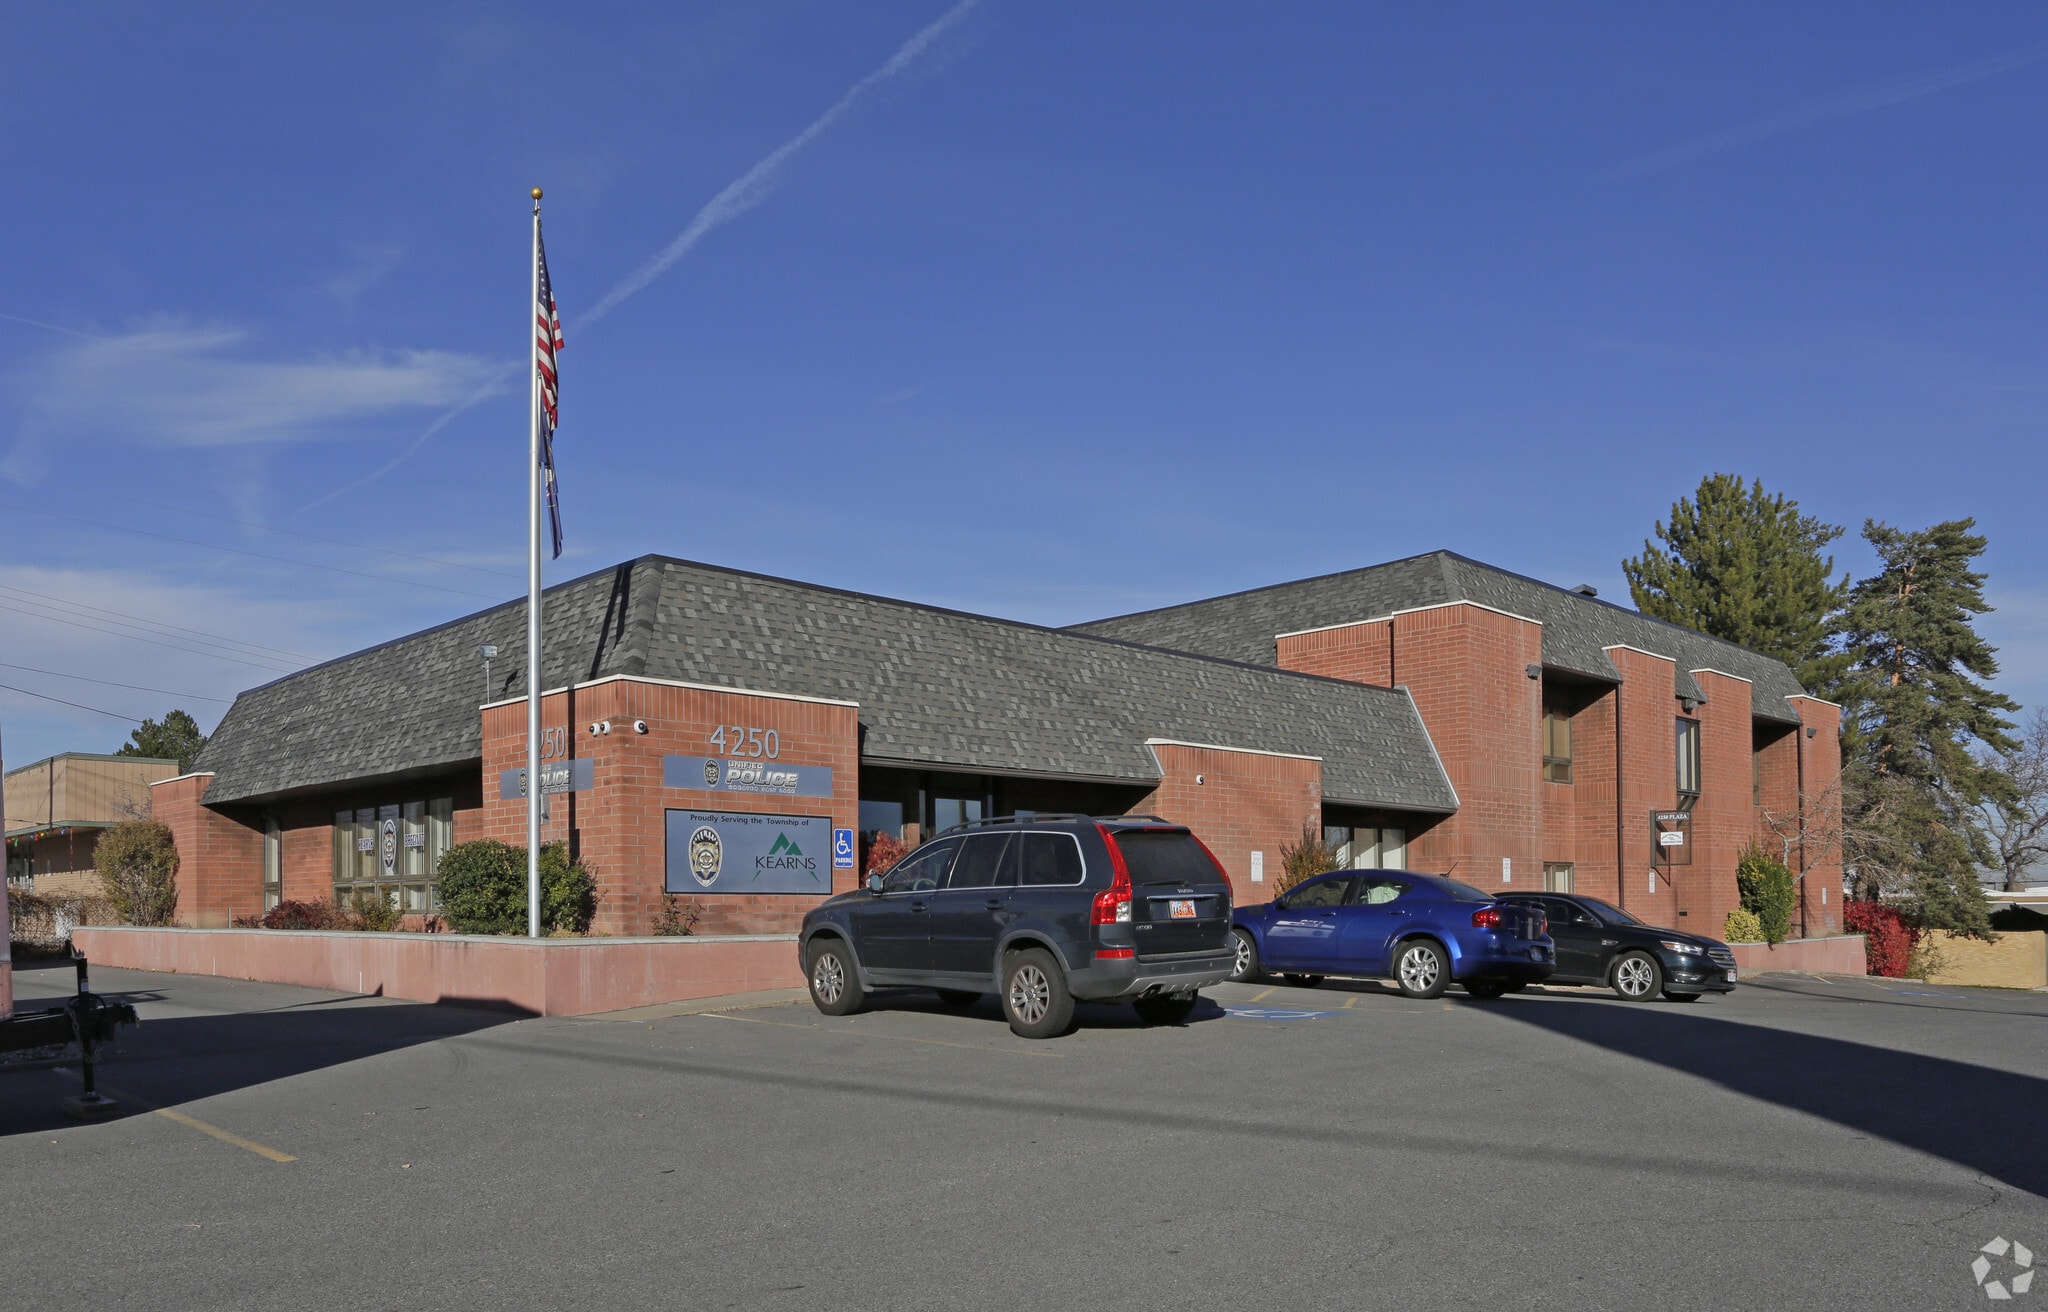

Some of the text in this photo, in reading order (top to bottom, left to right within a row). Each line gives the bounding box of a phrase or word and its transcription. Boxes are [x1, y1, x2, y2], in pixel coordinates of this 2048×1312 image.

[526, 727, 566, 759] 250
[709, 724, 780, 759] 4250
[728, 760, 764, 770] UNIFIED
[539, 769, 571, 788] OLICE
[725, 769, 799, 788] POLICE
[690, 814, 810, 827] Proudly Serving the Township of
[755, 855, 816, 870] KEARNS
